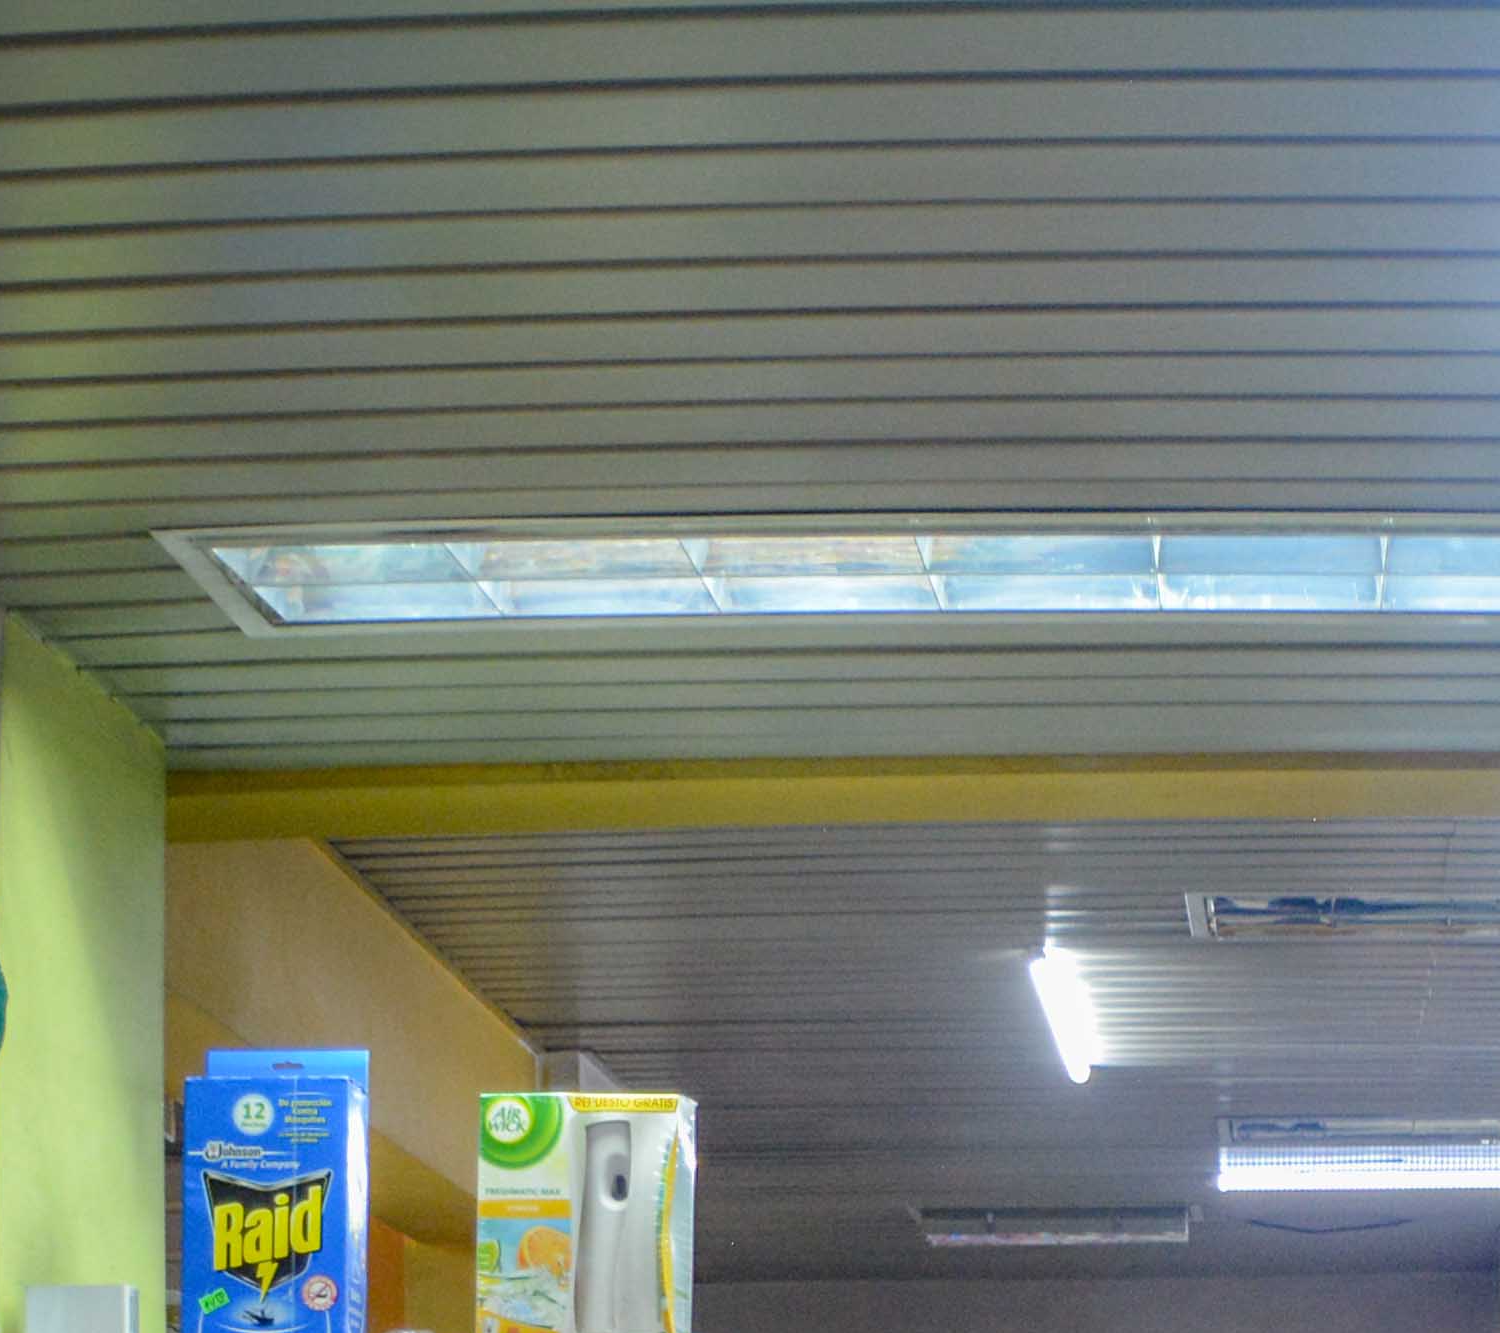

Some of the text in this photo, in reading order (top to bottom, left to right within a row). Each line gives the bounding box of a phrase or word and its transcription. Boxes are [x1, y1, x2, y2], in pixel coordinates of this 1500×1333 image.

[633, 1096, 675, 1109] GRATIS
[242, 1102, 265, 1119] 12
[492, 1106, 522, 1119] AIR
[487, 1118, 526, 1133] WICK
[221, 1160, 299, 1171] A Family Company
[212, 1185, 322, 1272] Raid
